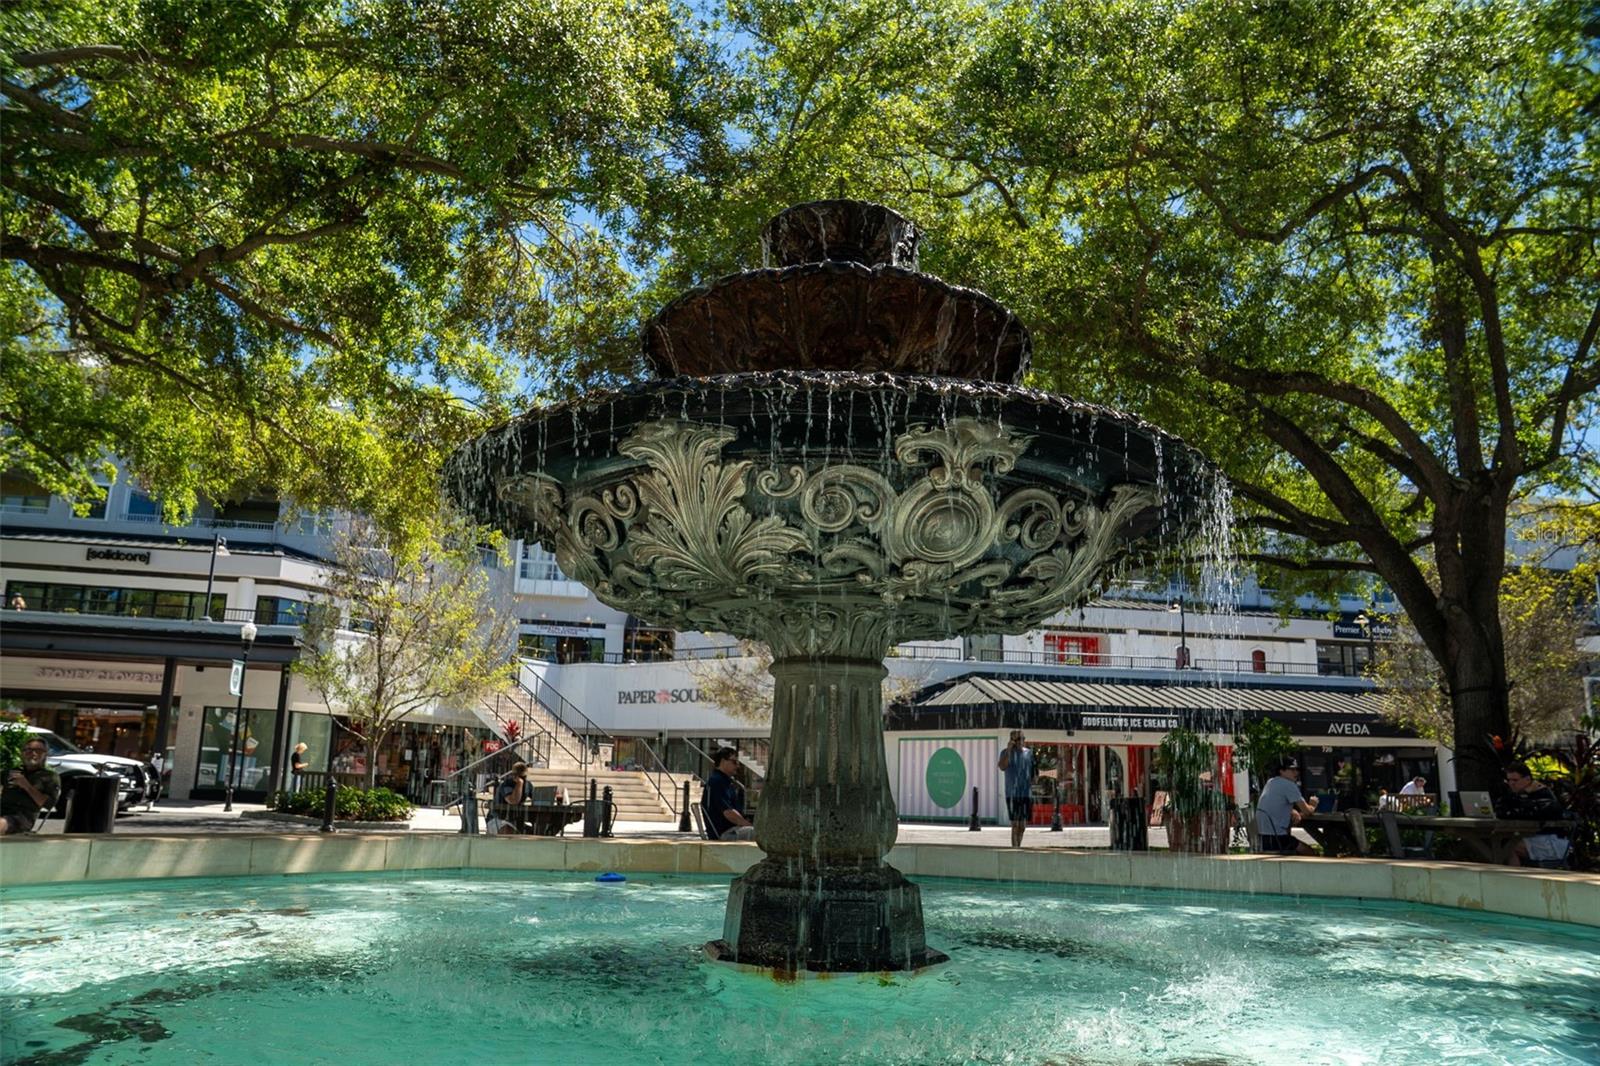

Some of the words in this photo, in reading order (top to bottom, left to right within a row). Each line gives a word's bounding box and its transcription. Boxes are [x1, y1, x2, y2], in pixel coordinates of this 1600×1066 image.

[1335, 625, 1360, 634] Premier
[34, 666, 93, 679] STONEY
[98, 671, 151, 682] CLOVER
[618, 690, 656, 704] PAPER
[671, 688, 711, 703] SOUR
[1082, 717, 1129, 727] ODDFELLOWS
[1130, 719, 1143, 728] ICE
[1143, 719, 1166, 729] CREAM
[1328, 722, 1370, 735] AVEDA
